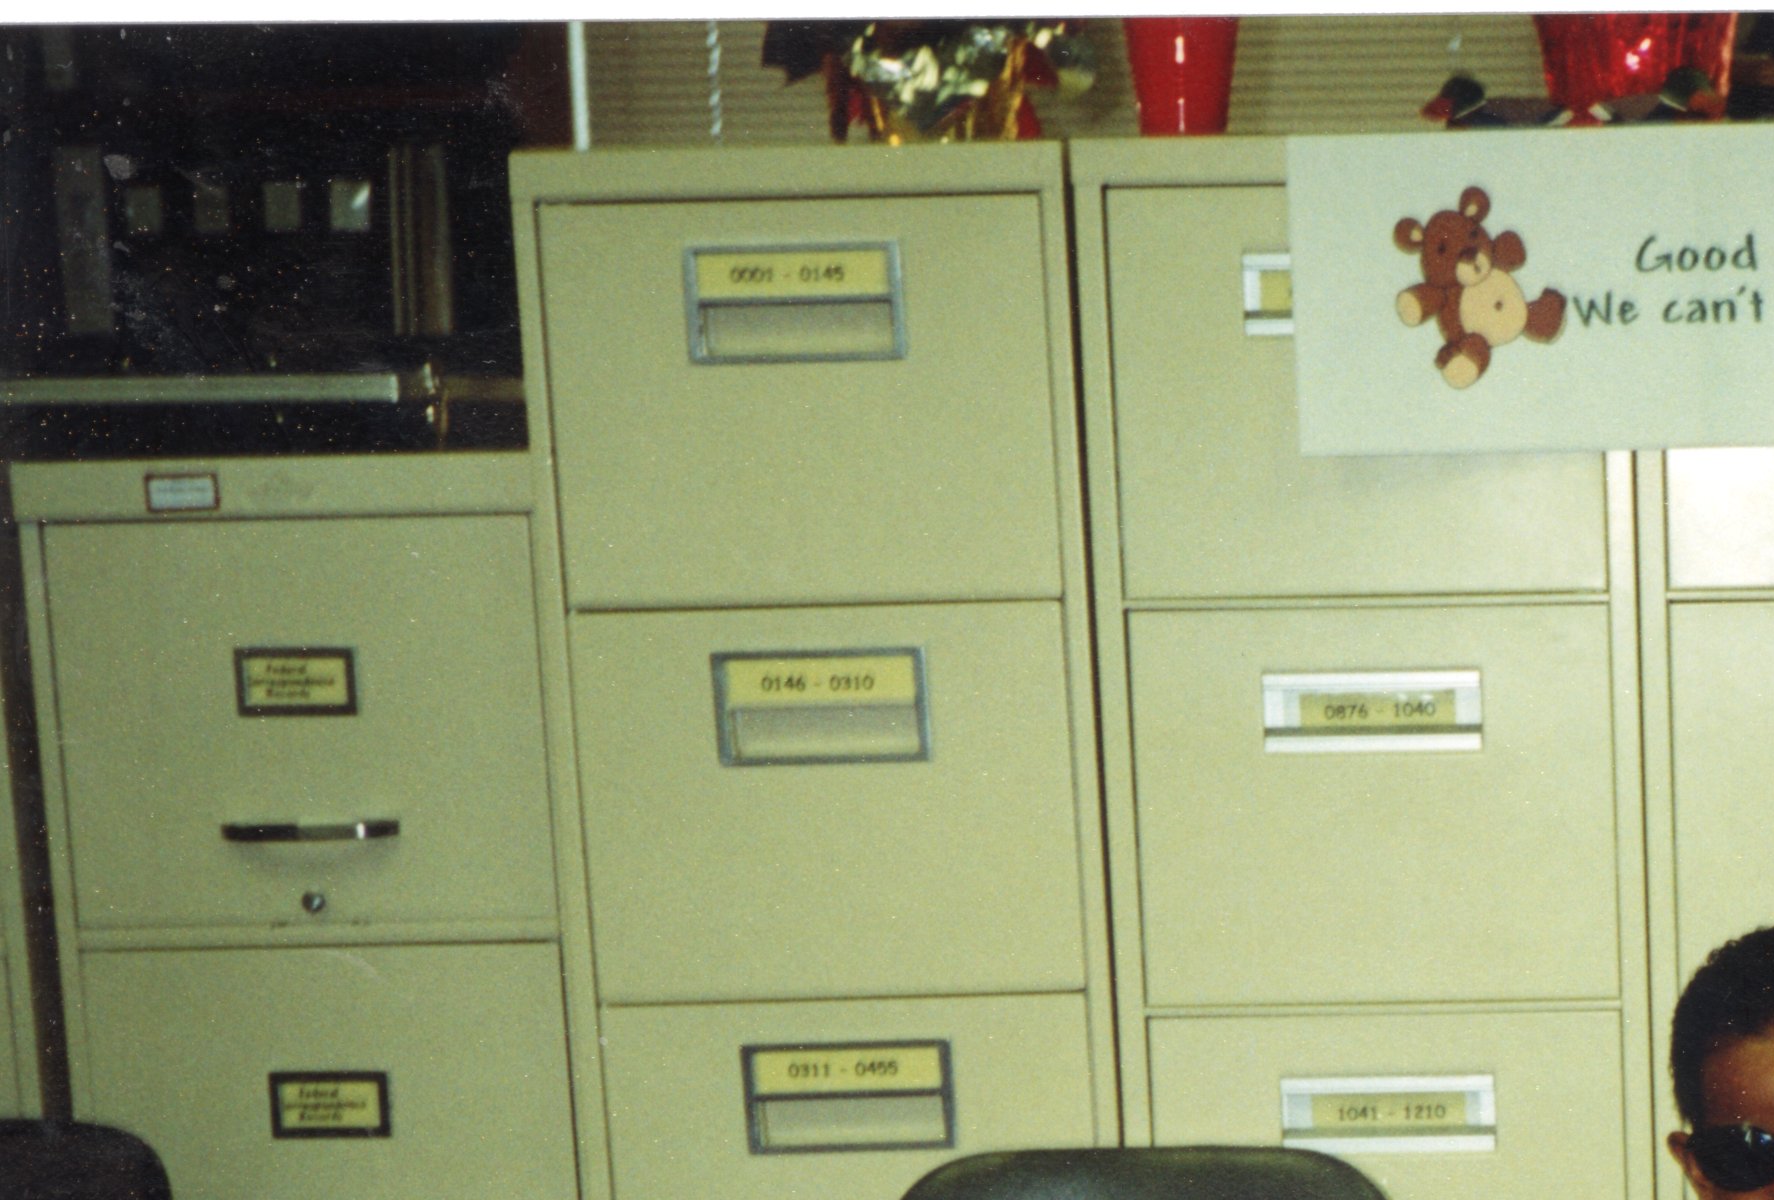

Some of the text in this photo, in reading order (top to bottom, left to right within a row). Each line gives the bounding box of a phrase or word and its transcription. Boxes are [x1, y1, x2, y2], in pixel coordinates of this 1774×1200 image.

[1634, 233, 1758, 272] Good
[730, 266, 774, 283] 0001
[798, 265, 845, 282] 0145
[1572, 290, 1639, 327] We
[1662, 285, 1763, 323] can't
[761, 676, 806, 692] 0146
[829, 675, 875, 691] 0310
[1324, 704, 1368, 719] 0876
[1393, 702, 1436, 717] 1040
[788, 1063, 832, 1078] 0311
[855, 1061, 899, 1077] 0455
[1338, 1106, 1378, 1121] 1041
[1404, 1104, 1447, 1120] 1210
